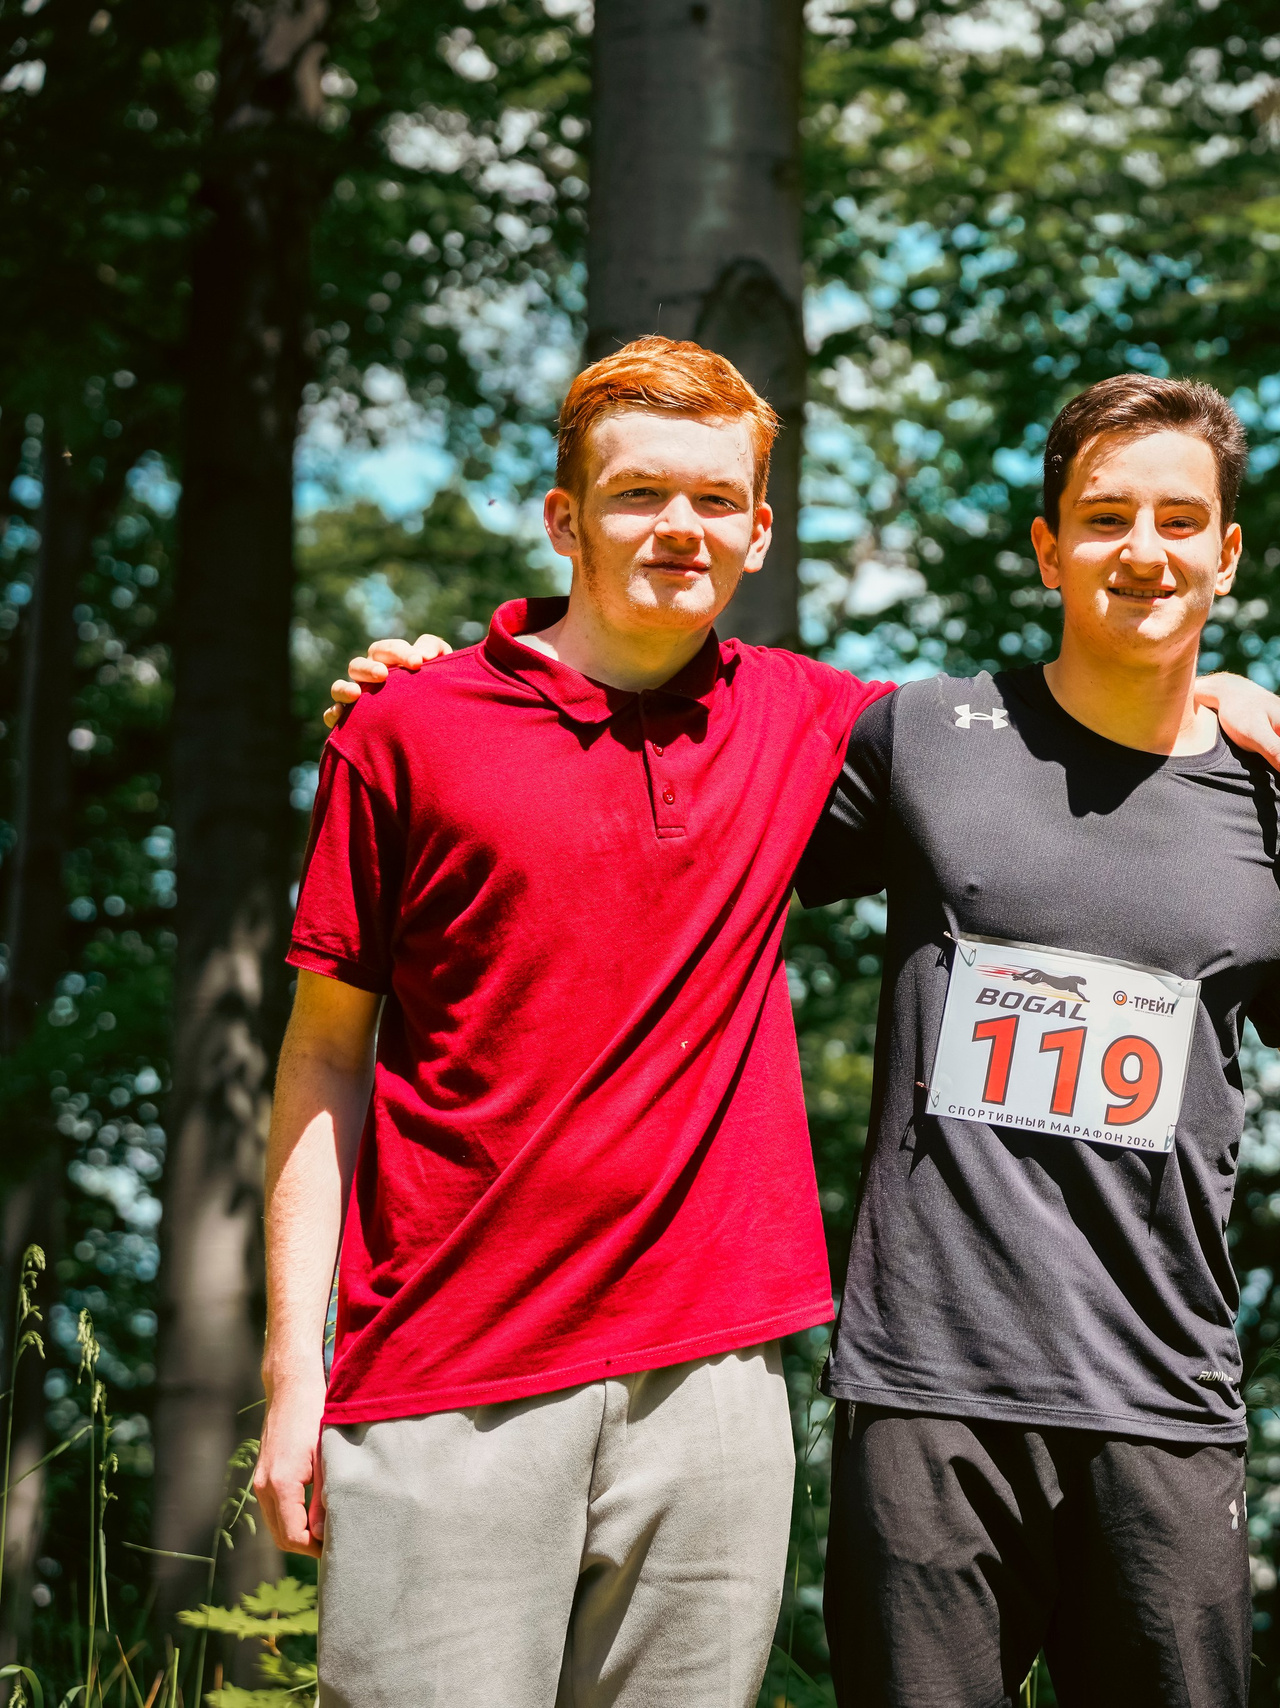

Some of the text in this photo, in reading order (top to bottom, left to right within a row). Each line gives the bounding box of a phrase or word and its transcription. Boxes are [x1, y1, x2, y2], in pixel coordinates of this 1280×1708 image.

[975, 987, 1088, 1022] BOGAL
[971, 1014, 1163, 1127] 119
[947, 1103, 1156, 1149] СПОРТИВНЫЙ МАРАФОН 2026
